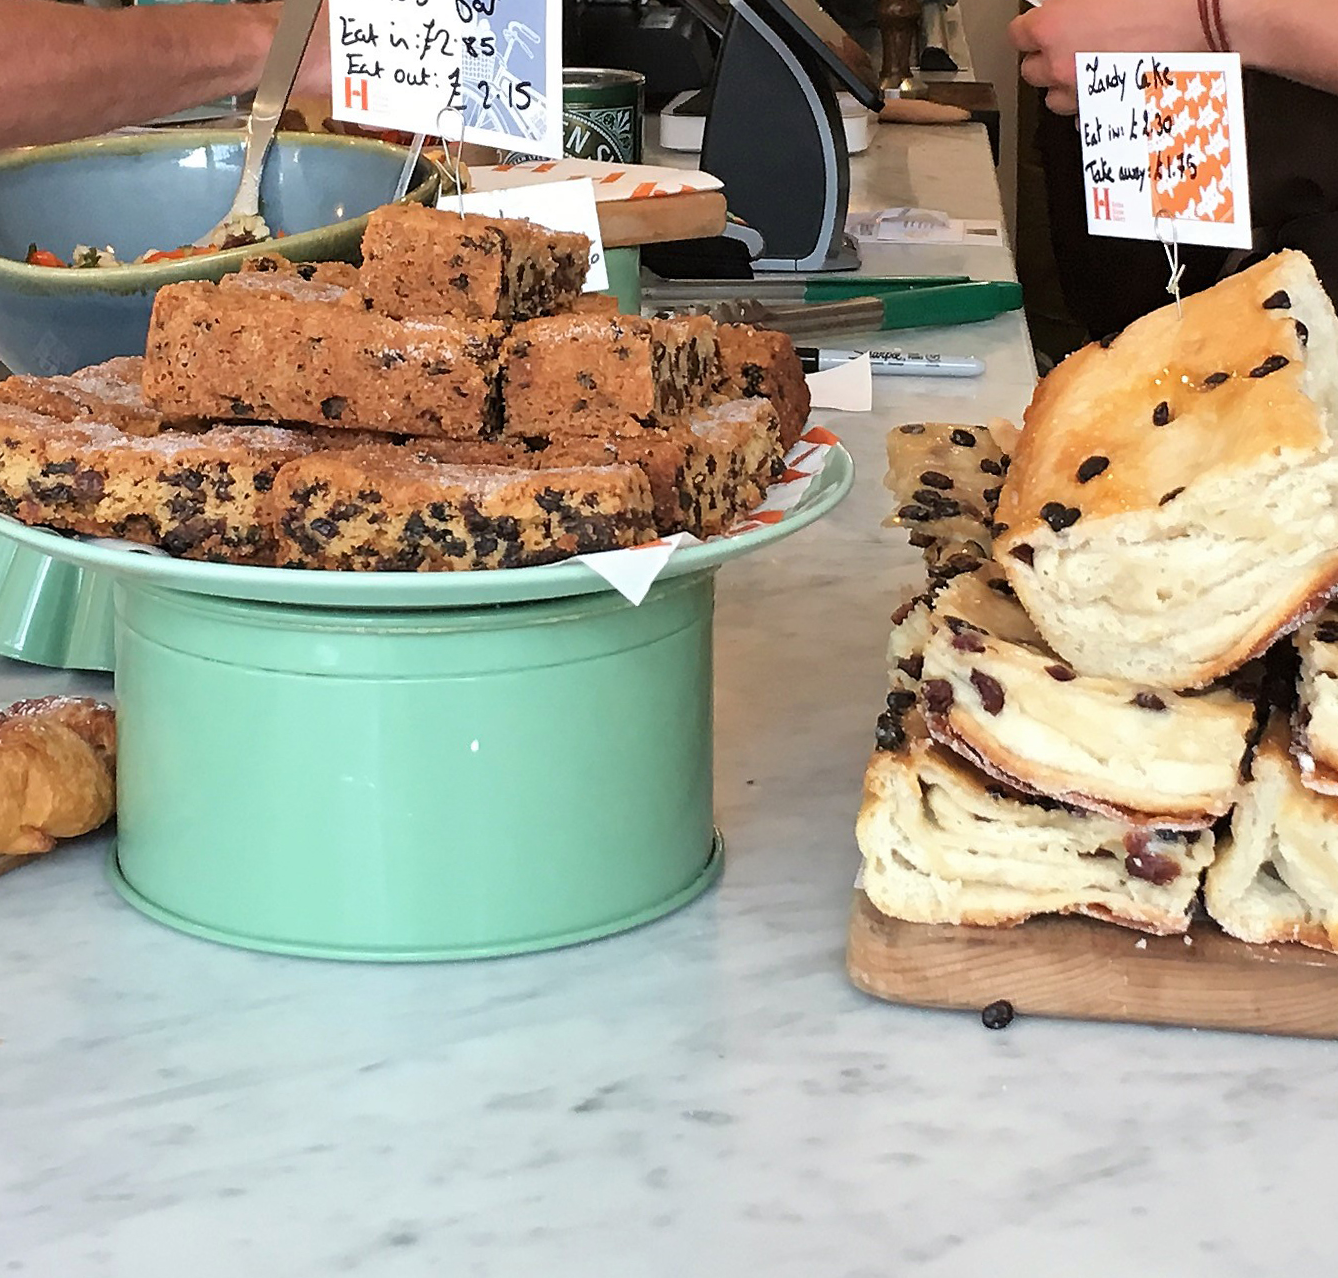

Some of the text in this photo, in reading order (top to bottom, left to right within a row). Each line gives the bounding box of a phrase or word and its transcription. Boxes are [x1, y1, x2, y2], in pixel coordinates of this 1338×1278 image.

[340, 16, 378, 47] Eat
[346, 53, 384, 78] Eat
[344, 76, 368, 110] H
[1084, 117, 1102, 146] Eat
[1085, 158, 1114, 183] Take
[1092, 187, 1112, 220] H
